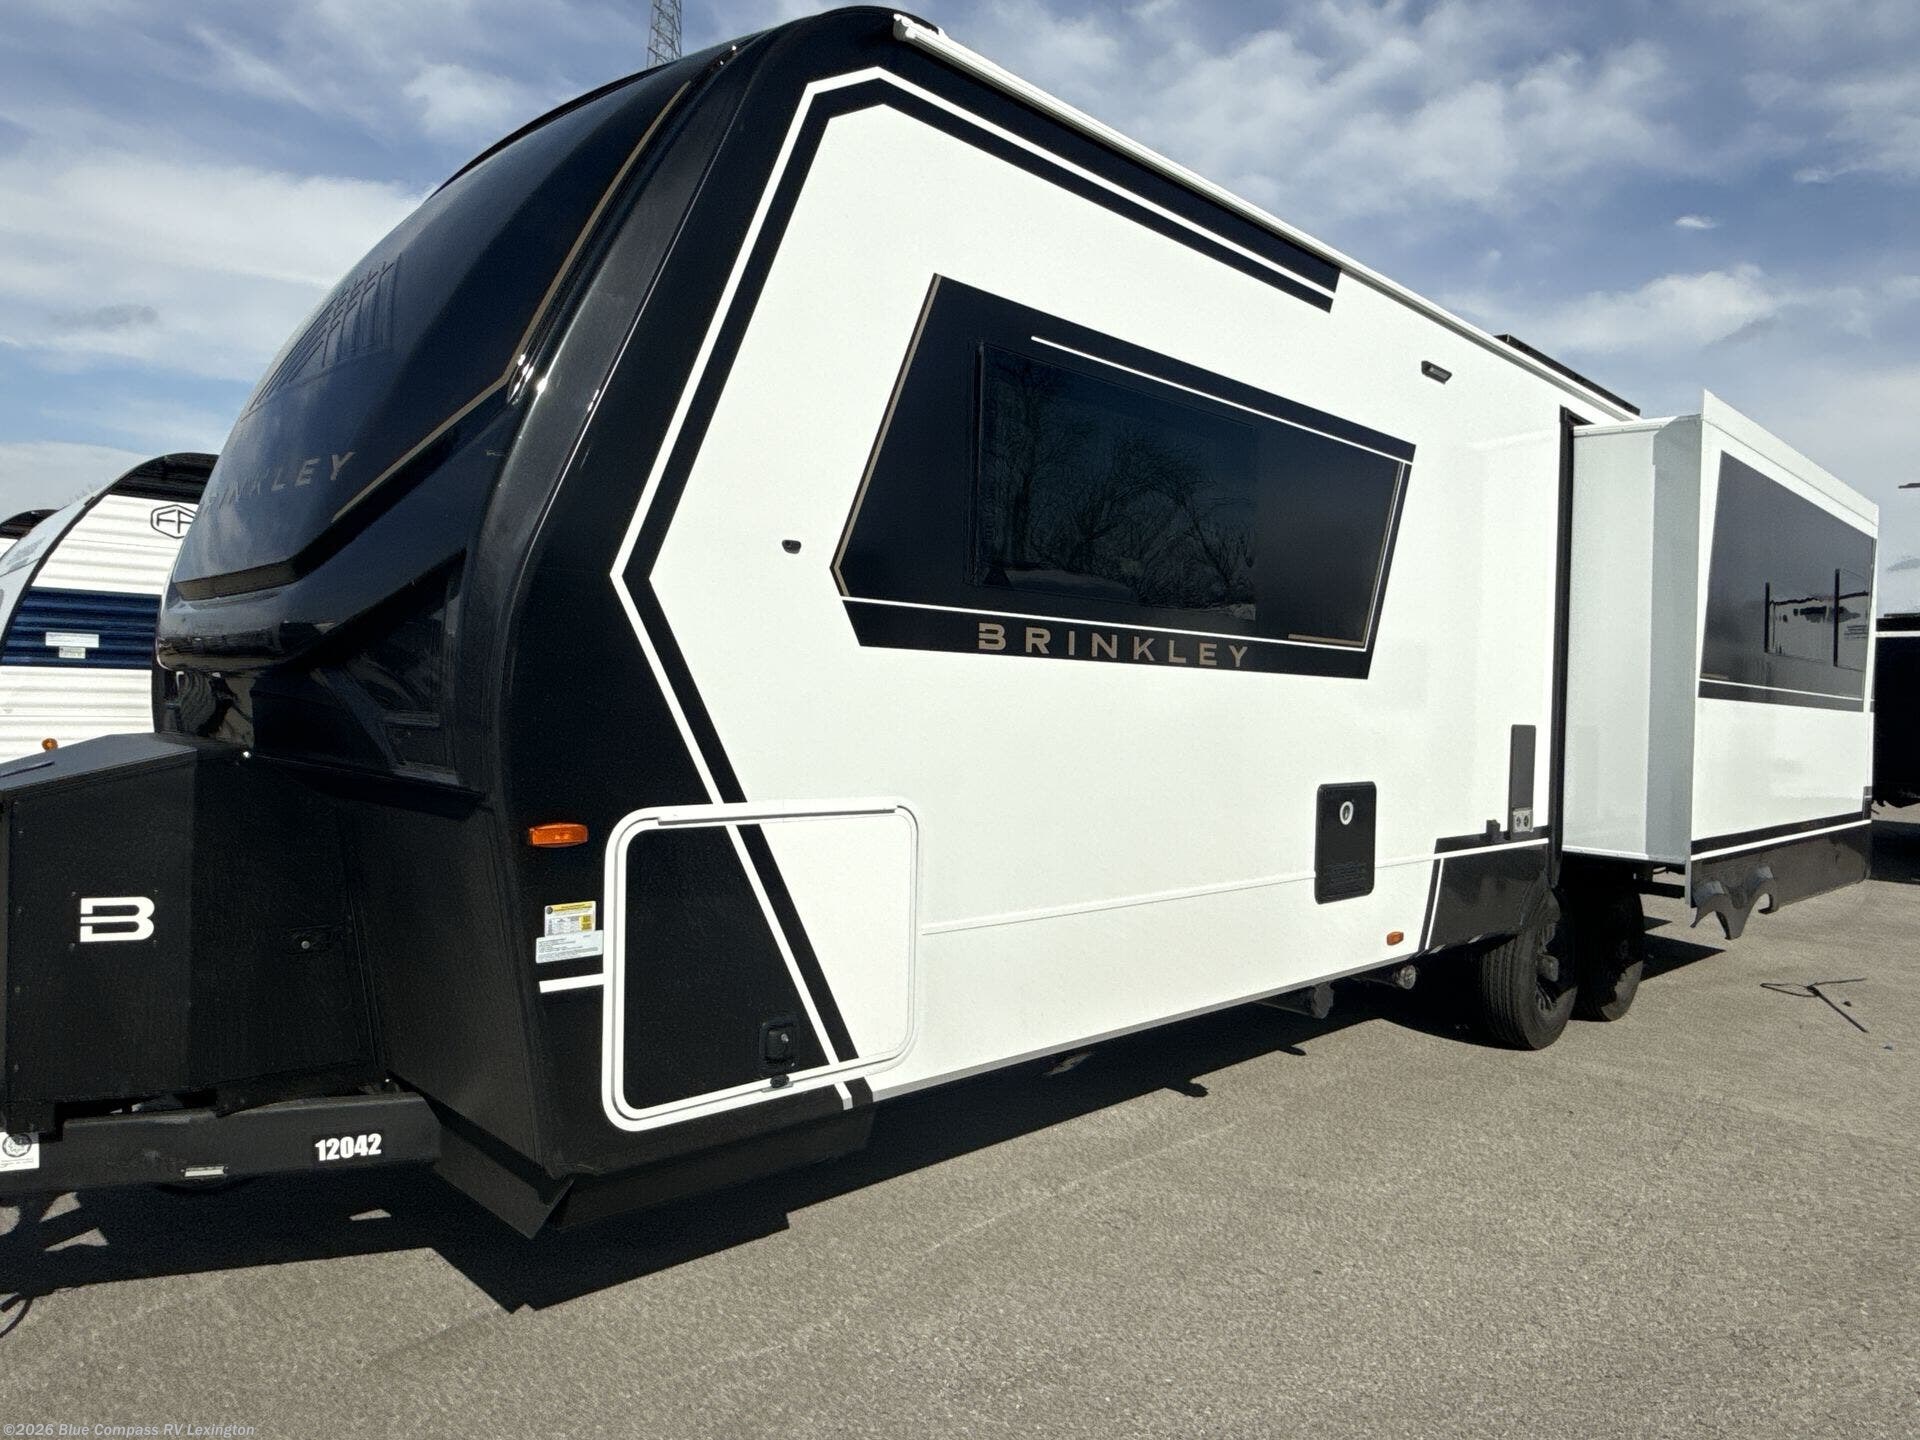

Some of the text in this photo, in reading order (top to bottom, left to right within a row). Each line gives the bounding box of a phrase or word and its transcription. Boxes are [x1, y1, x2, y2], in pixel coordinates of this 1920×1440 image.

[978, 622, 1248, 667] BRINKLEY
[80, 896, 155, 942] B
[314, 1133, 382, 1161] 12042
